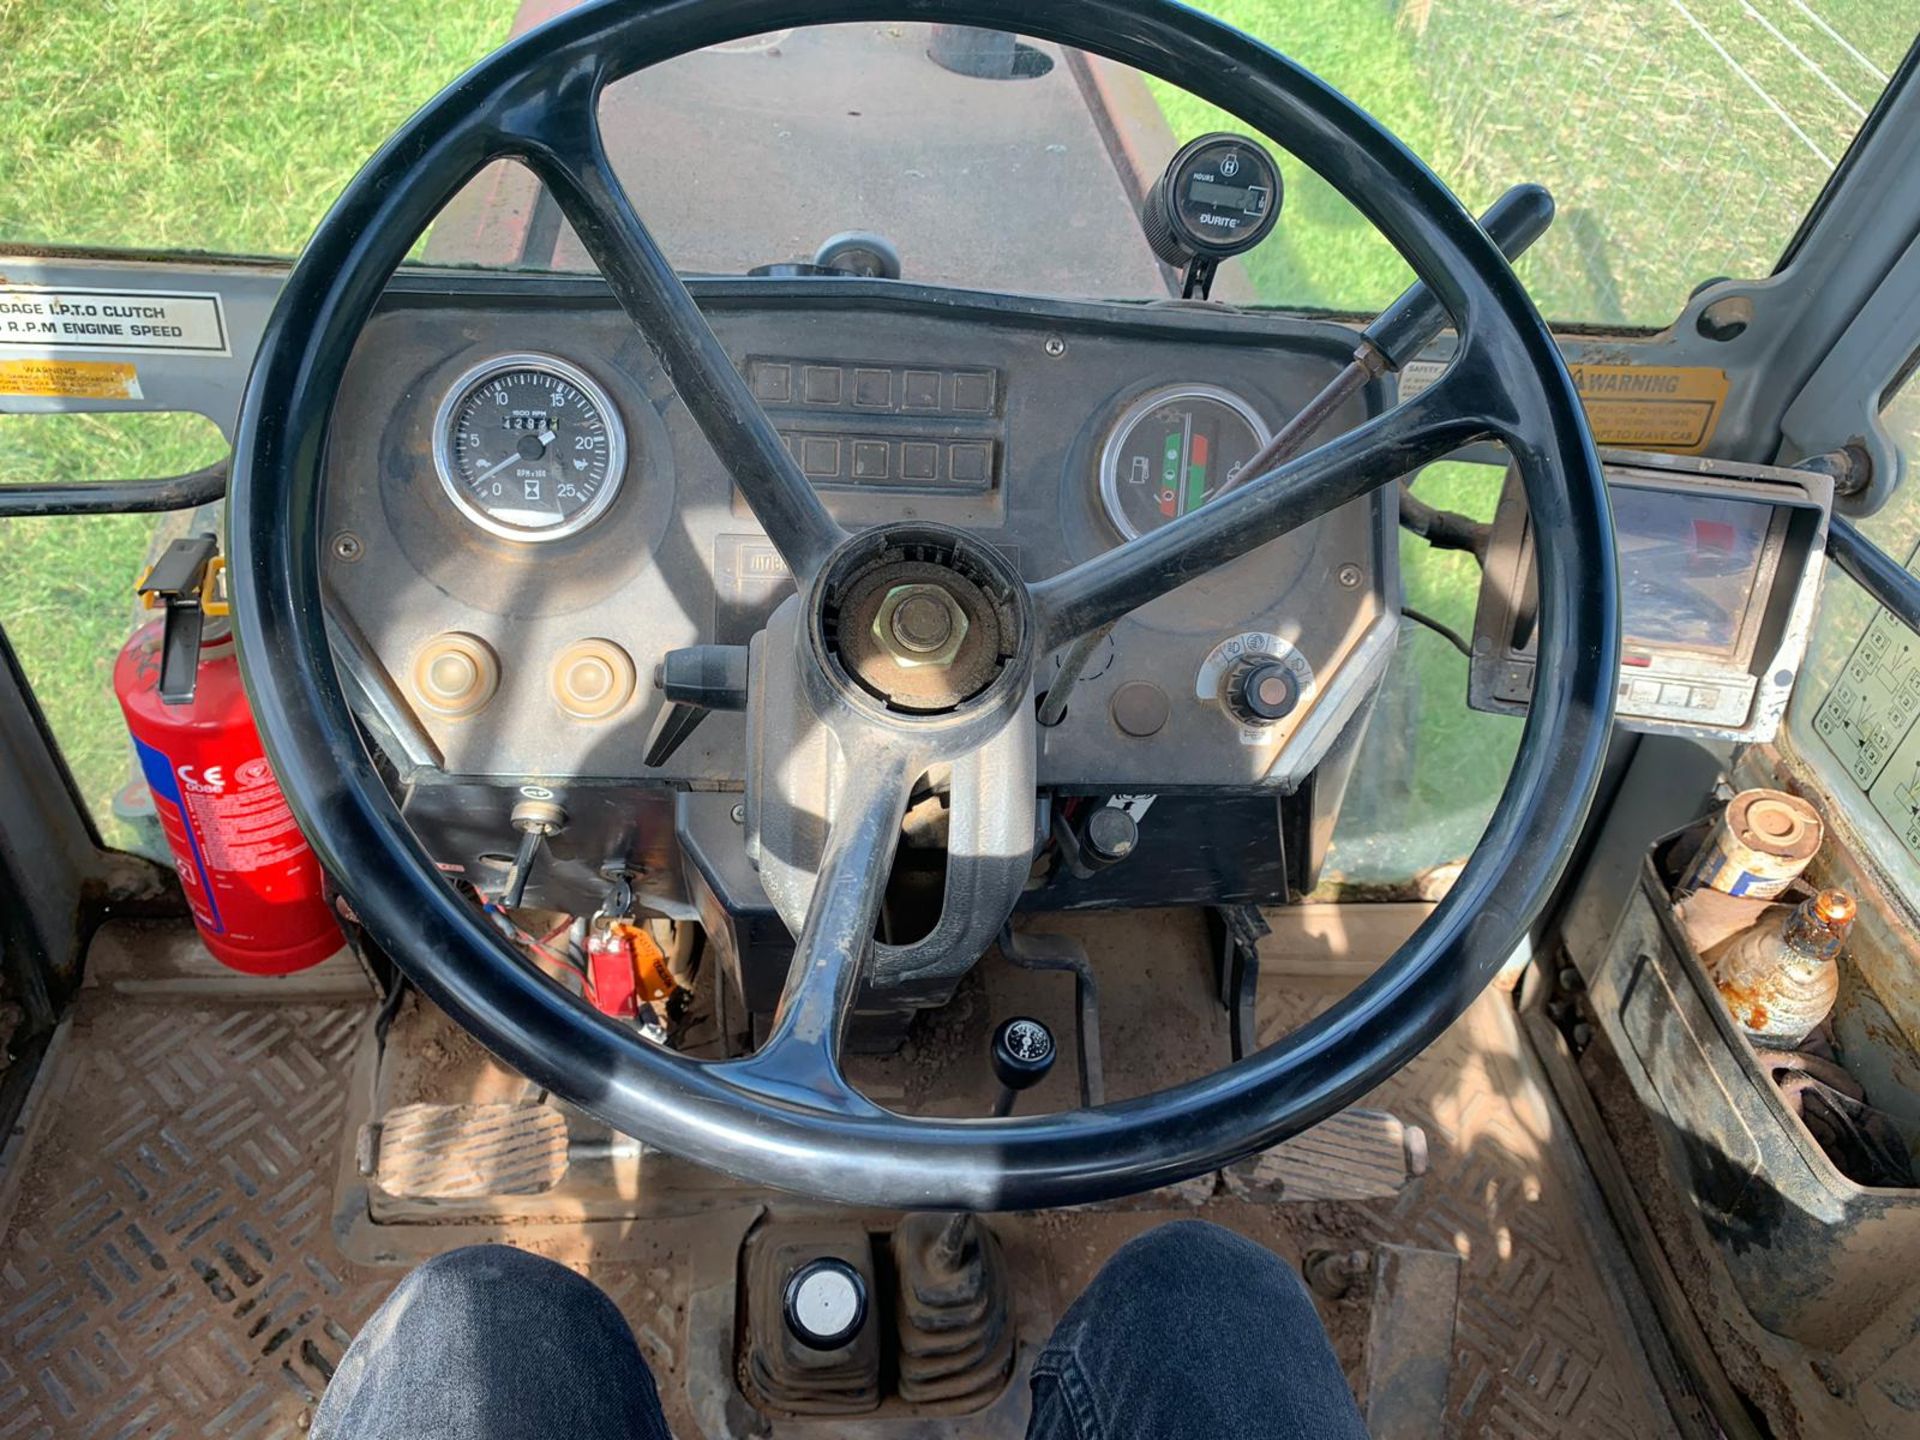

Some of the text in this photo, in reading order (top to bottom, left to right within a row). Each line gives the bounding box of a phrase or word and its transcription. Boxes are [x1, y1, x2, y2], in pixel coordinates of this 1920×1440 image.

[1200, 213, 1237, 228] DURITE
[103, 306, 165, 319] CLUTCH
[64, 323, 123, 336] ENGINE
[130, 325, 182, 337] SPEED
[23, 366, 77, 375] WARNING
[1590, 373, 1681, 393] WARNING
[495, 392, 508, 406] 10
[551, 393, 565, 407] 15
[470, 433, 480, 447] 5
[1671, 431, 1692, 440] CAB
[575, 436, 594, 450] 20
[492, 483, 502, 496] 0
[557, 483, 576, 497] 25
[177, 764, 226, 787] CE
